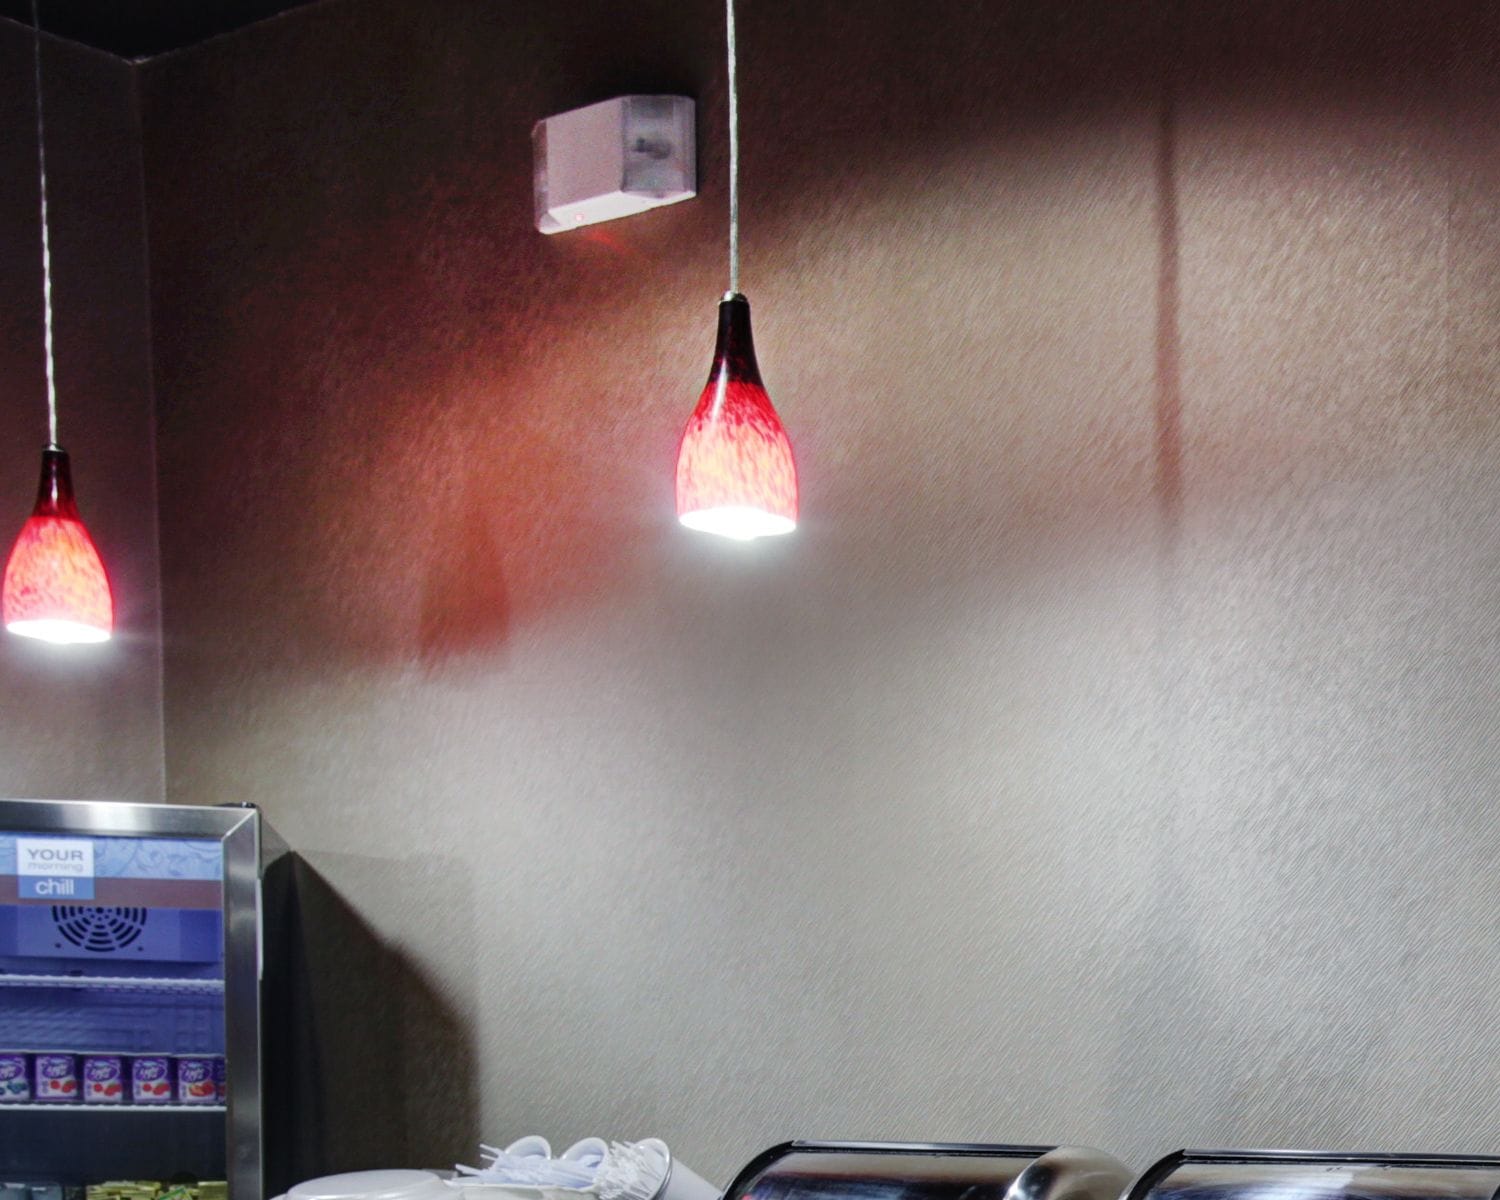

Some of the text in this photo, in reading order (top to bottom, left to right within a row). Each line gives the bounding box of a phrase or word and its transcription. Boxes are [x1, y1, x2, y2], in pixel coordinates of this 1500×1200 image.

[27, 848, 84, 861] YOUR
[27, 863, 84, 873] morning
[35, 878, 75, 895] chill
